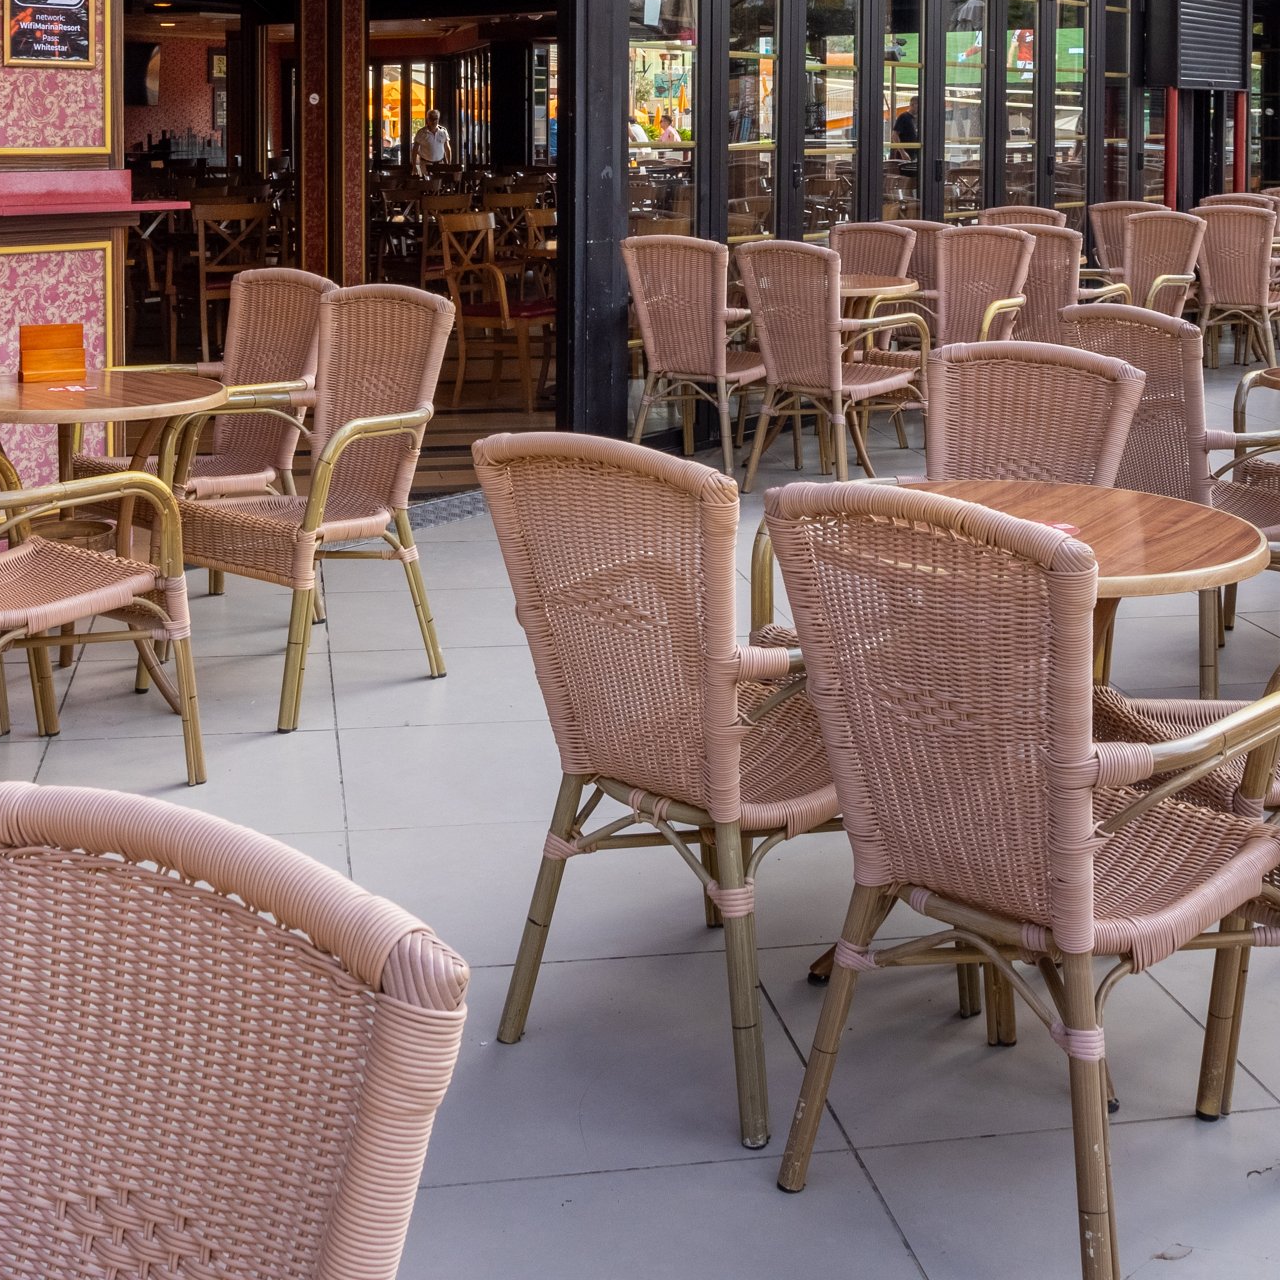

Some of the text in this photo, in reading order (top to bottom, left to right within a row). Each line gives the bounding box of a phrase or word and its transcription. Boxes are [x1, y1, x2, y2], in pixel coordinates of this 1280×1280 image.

[35, 13, 66, 22] network:
[19, 21, 81, 32] WifiMarinaResort
[33, 42, 68, 52] Whitestar
